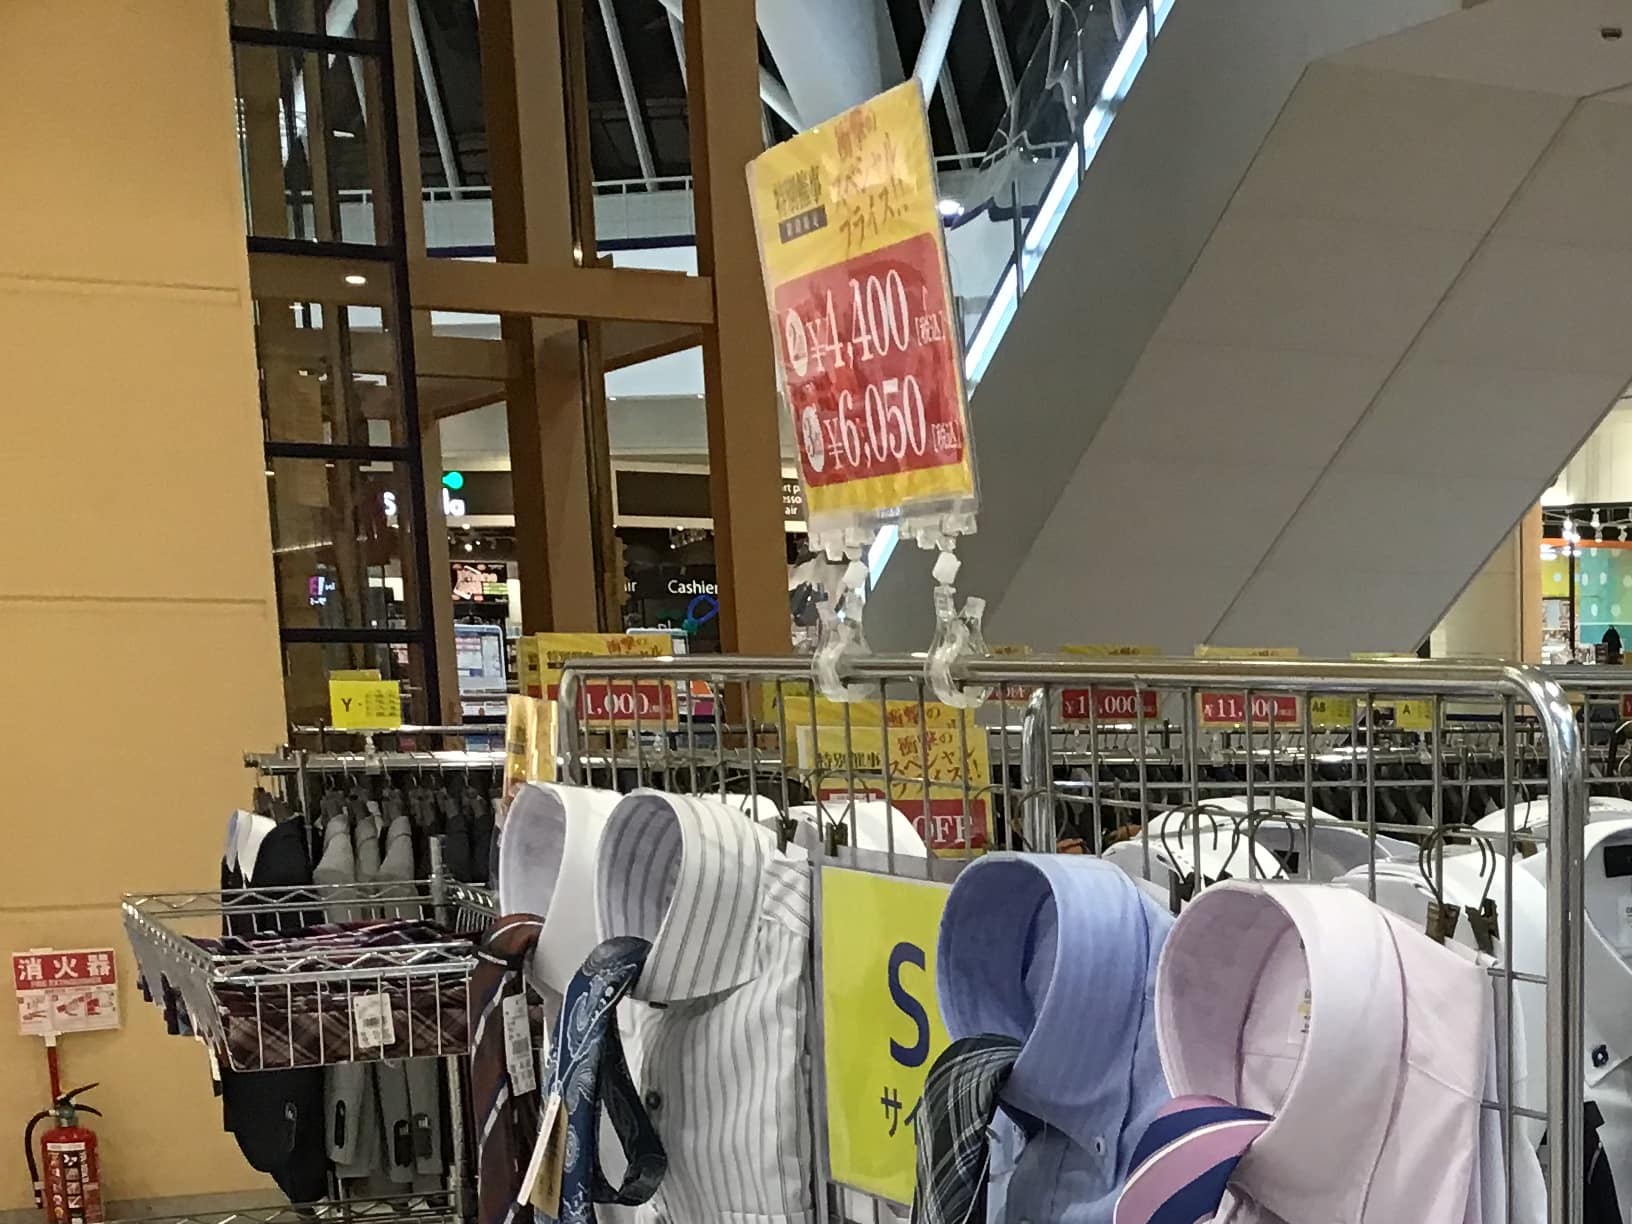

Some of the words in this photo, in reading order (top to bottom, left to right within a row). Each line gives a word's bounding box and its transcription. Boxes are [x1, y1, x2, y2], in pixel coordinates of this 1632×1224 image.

[807, 269, 911, 375] ¥4,400
[824, 375, 927, 468] ¥6,050
[668, 580, 719, 594] Cashier
[341, 698, 352, 712] Y
[18, 954, 111, 980] 消火器
[888, 941, 930, 1068] S
[880, 1086, 923, 1146] サイ
